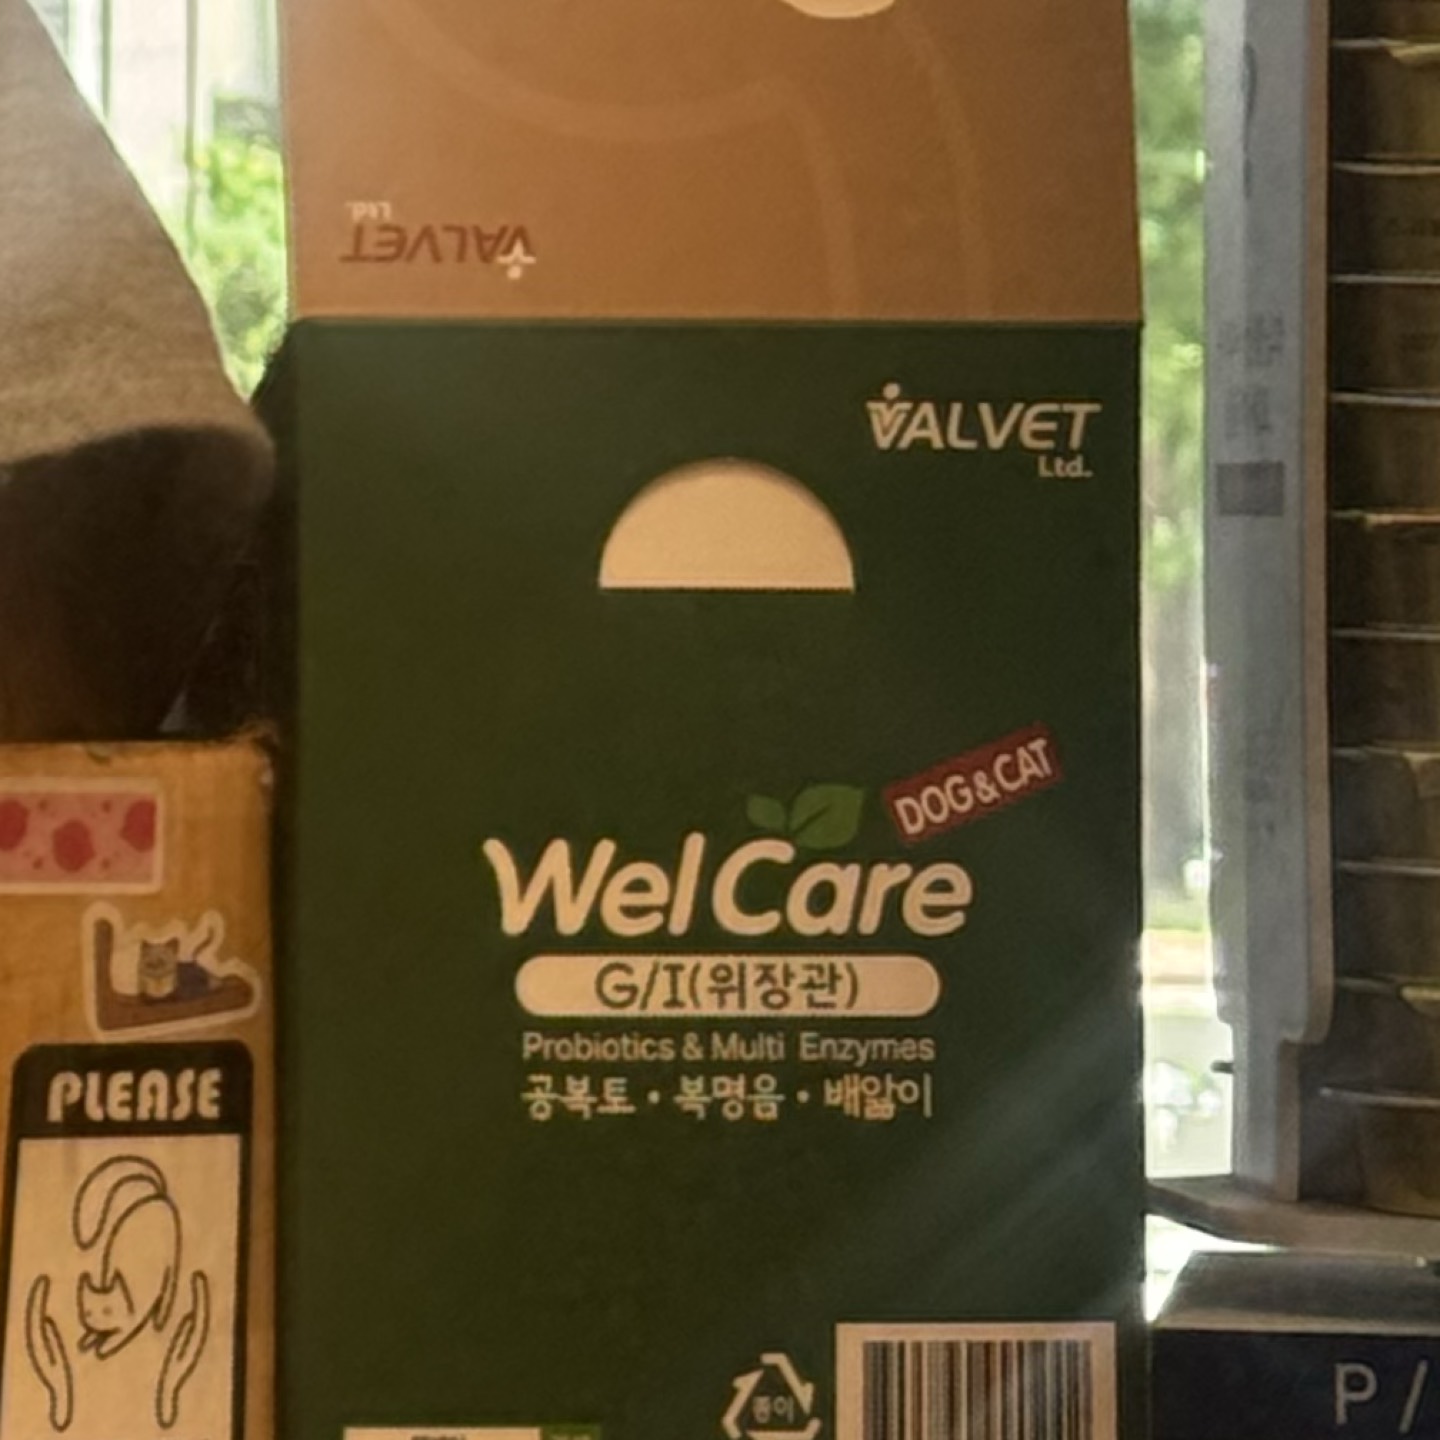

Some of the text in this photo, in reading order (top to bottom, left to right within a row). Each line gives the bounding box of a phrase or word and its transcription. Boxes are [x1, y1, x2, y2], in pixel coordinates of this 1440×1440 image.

[865, 382, 1102, 451] VALVET
[1037, 455, 1094, 478] Ltd.
[892, 736, 1056, 838] DOG&CAT
[521, 1031, 936, 1068] Probiotics & Multi Enzymes
[48, 1067, 224, 1125] PLEASE
